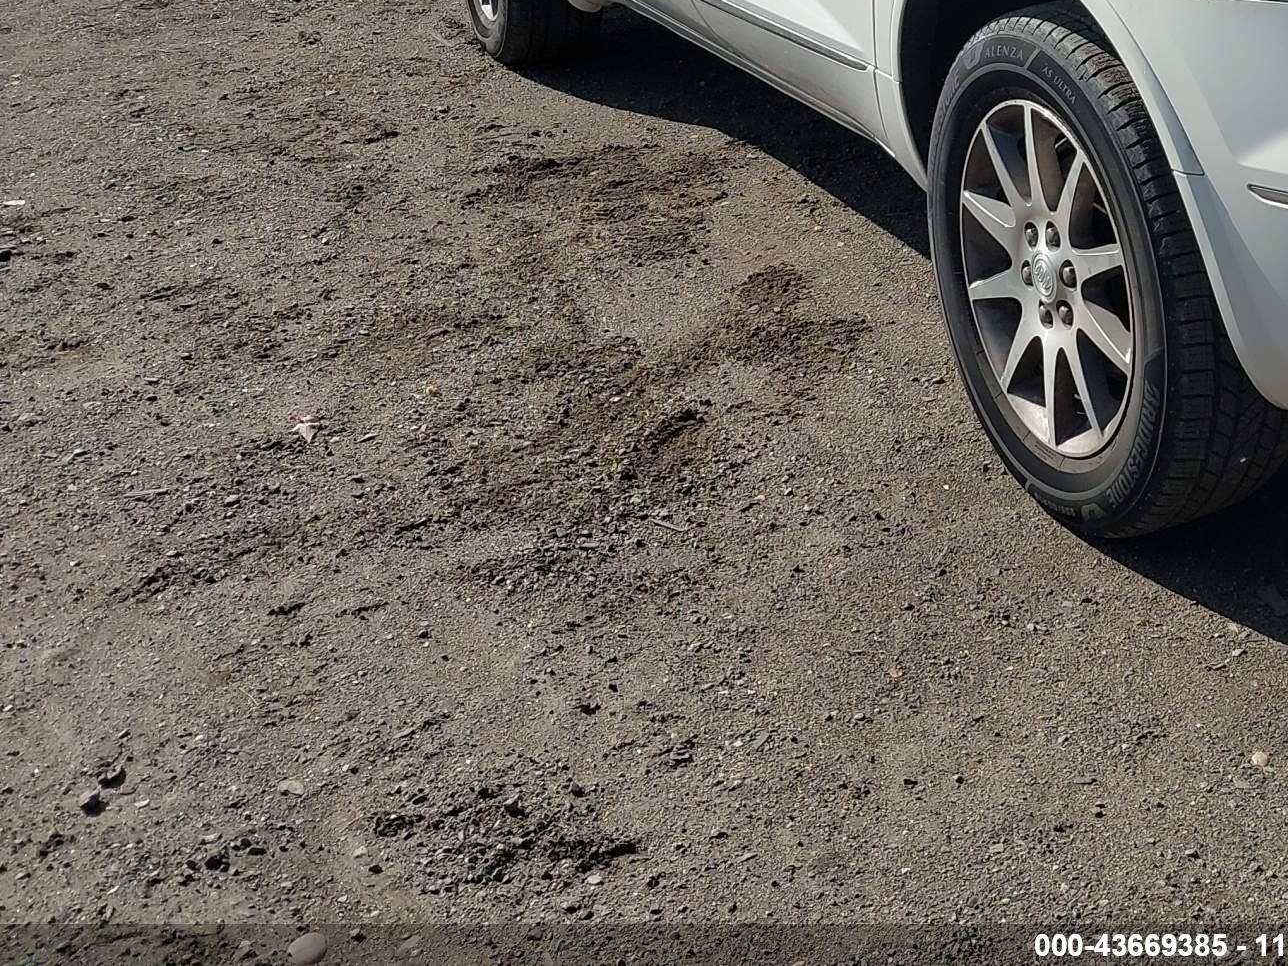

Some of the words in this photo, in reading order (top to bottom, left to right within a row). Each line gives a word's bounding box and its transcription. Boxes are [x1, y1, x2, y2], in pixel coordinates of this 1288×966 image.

[984, 44, 1023, 61] ALENZA
[1054, 77, 1076, 105] ULTRA
[1105, 379, 1161, 508] BRIDGESTONE
